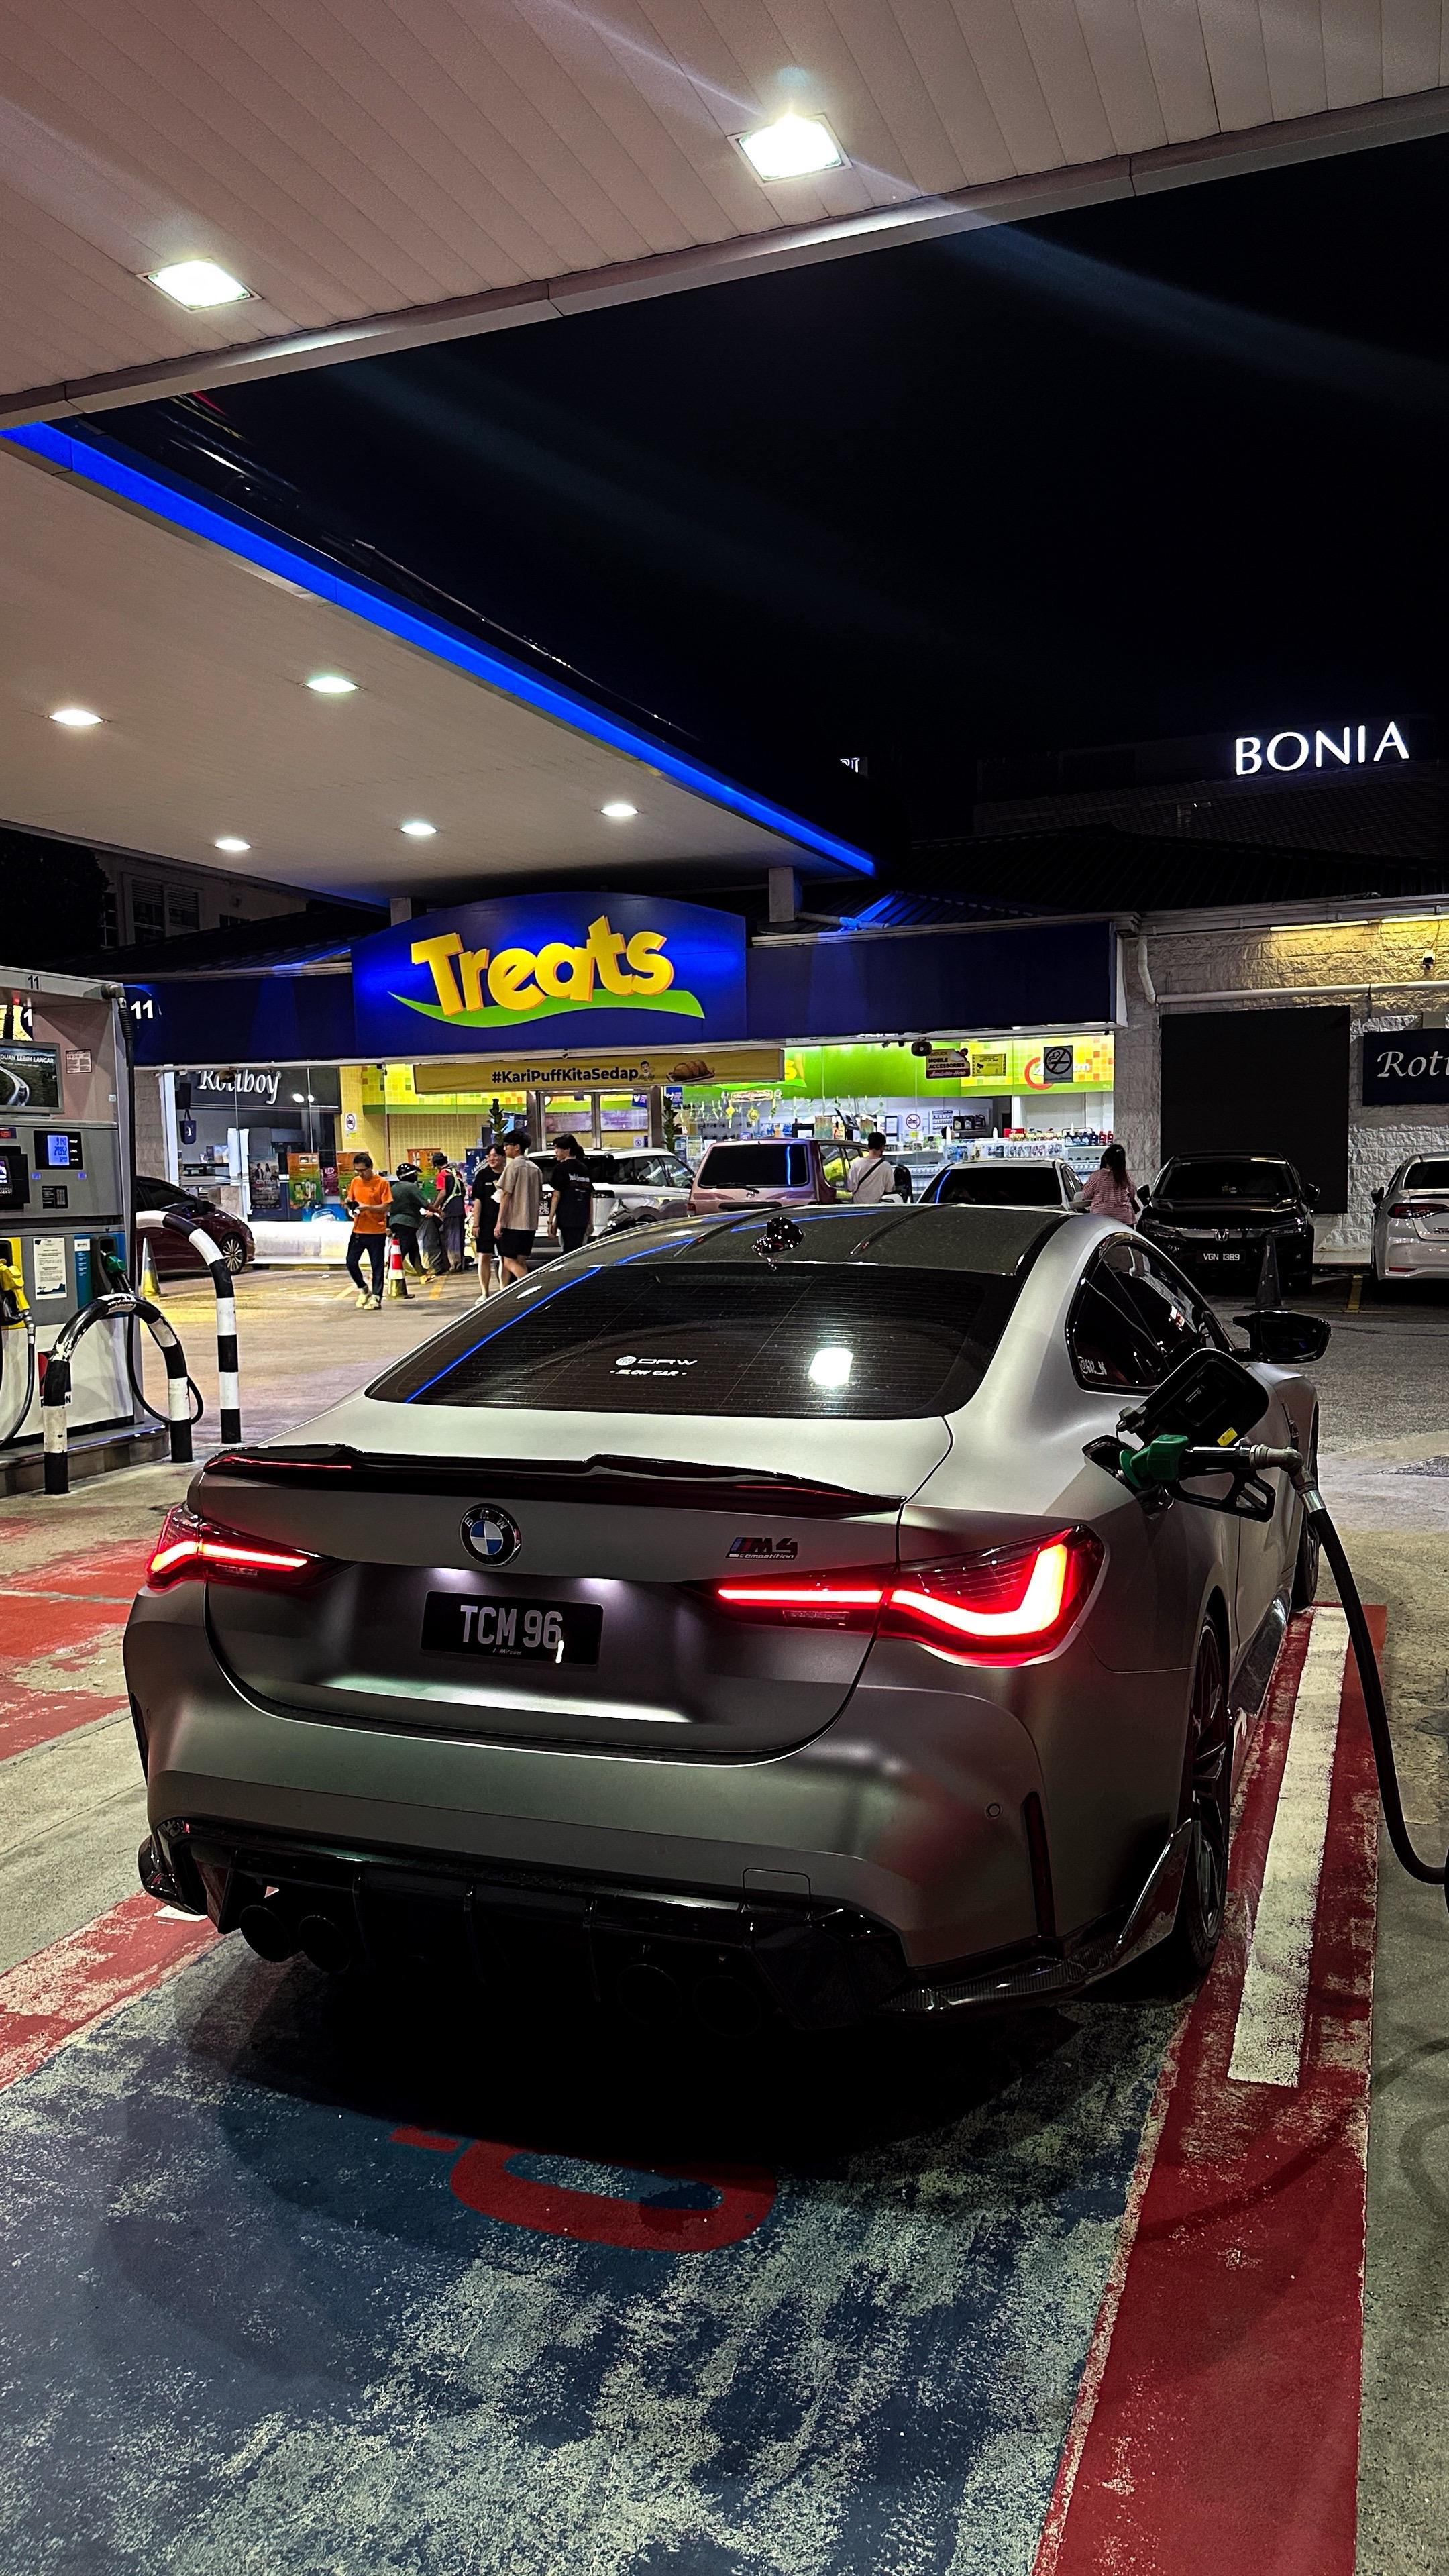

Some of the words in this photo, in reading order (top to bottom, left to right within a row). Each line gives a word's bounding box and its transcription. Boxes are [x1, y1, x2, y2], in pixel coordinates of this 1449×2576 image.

[1236, 721, 1409, 775] BONIA
[411, 915, 674, 1016] Treats
[28, 975, 40, 990] 11
[131, 1000, 154, 1020] 11
[492, 1067, 639, 1083] #KariPuffKitaSedap
[1203, 1253, 1219, 1261] VGN
[1222, 1253, 1240, 1261] 1389
[750, 1537, 798, 1554] M4
[460, 1604, 515, 1648] TCM
[523, 1610, 564, 1650] 96
